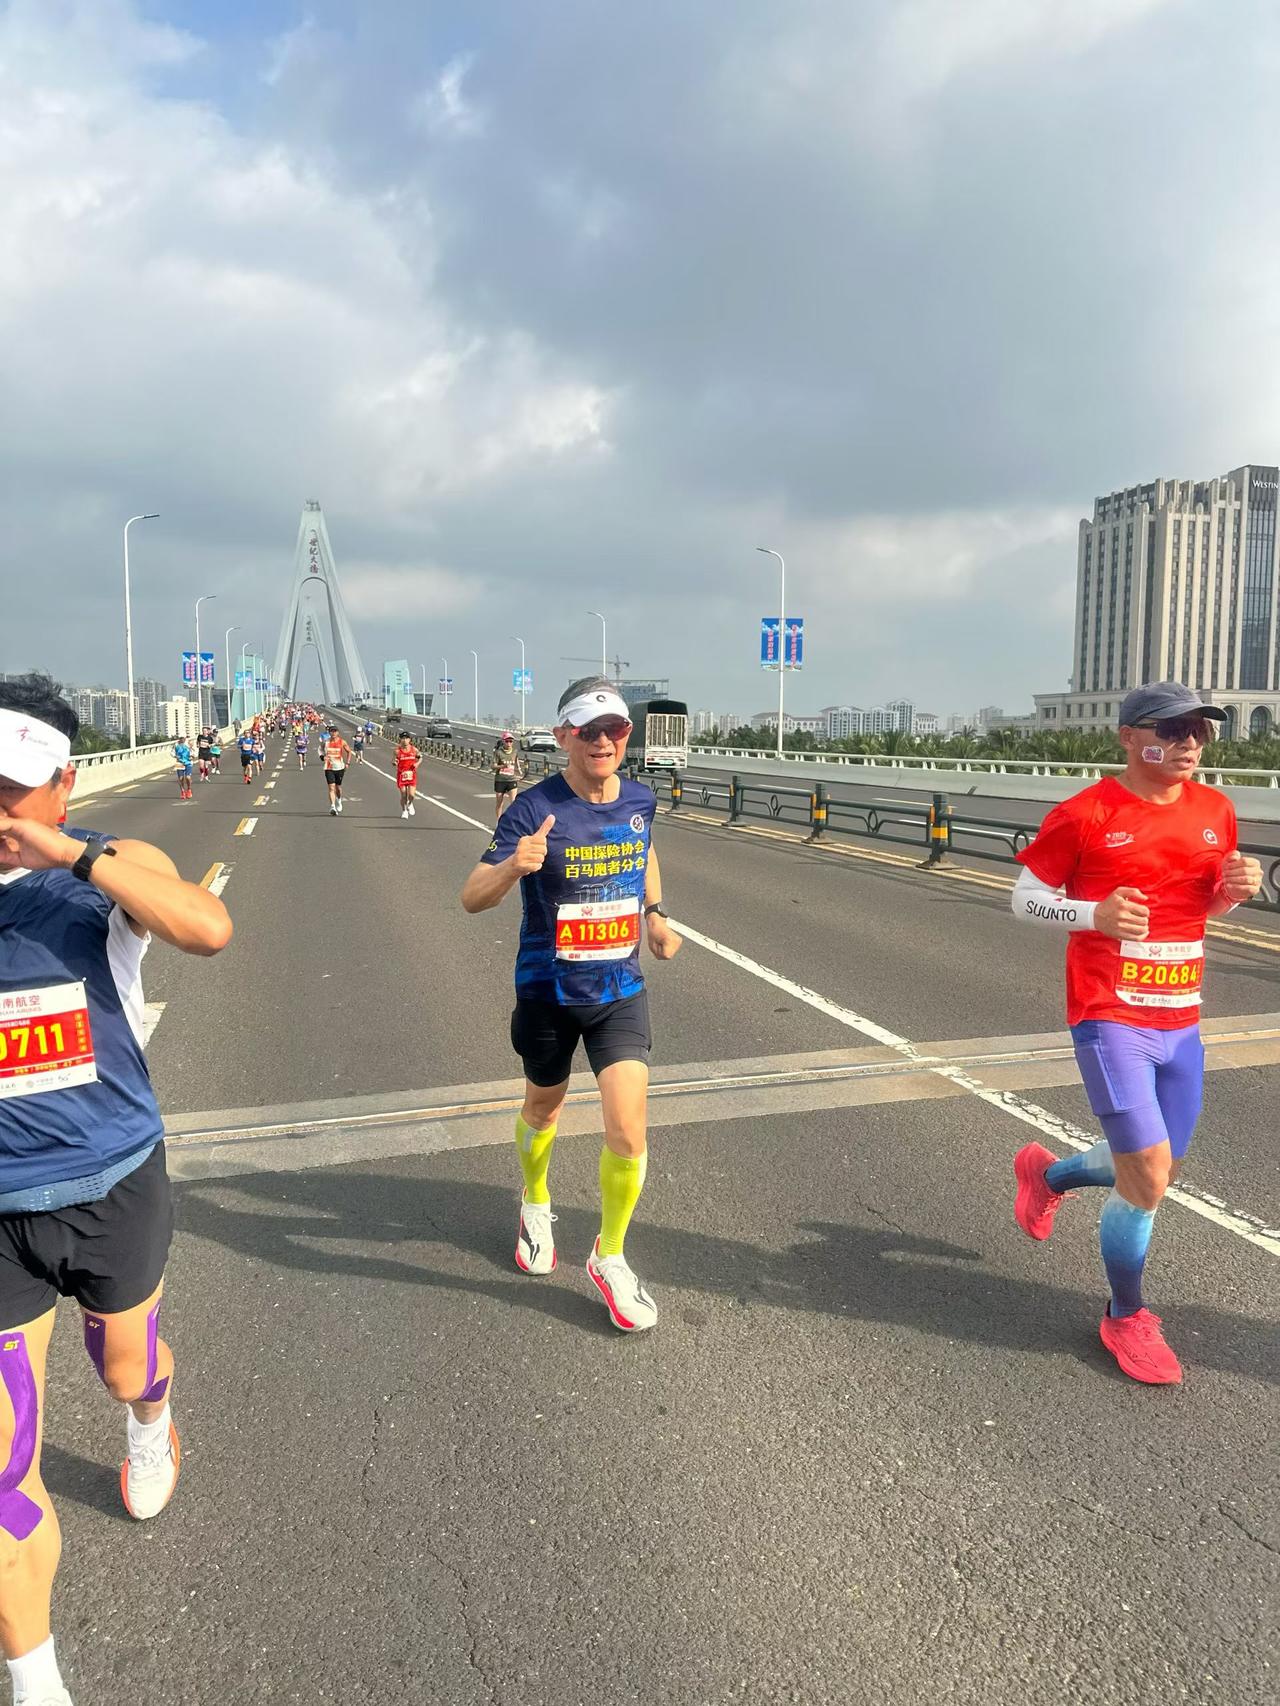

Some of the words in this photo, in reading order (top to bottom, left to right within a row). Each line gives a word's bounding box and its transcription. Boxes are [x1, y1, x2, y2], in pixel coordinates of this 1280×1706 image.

[565, 840, 645, 861] 中国探险协会
[565, 857, 645, 878] 百马跑者分会
[1025, 900, 1077, 922] SUUNTO
[560, 924, 573, 939] A
[579, 921, 629, 941] 11306
